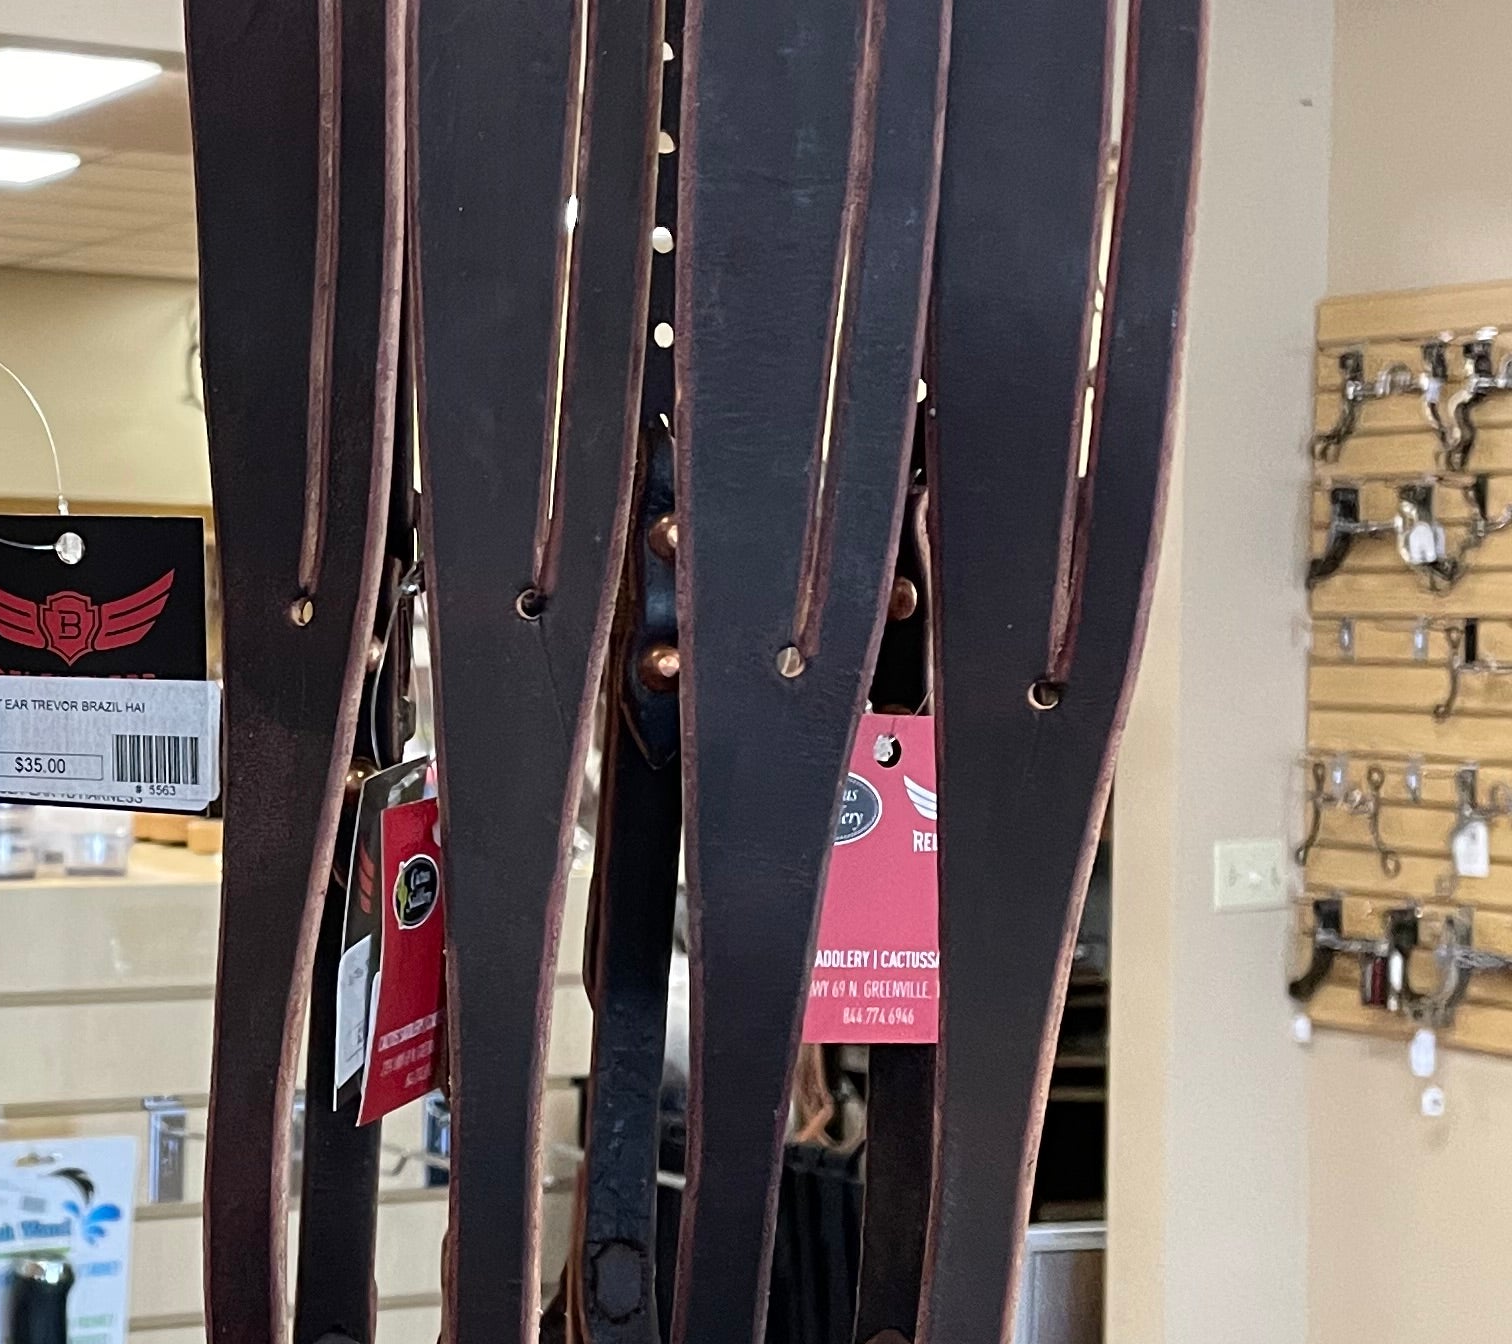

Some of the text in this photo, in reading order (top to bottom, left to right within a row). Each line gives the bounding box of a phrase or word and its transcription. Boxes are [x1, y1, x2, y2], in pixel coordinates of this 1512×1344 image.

[5, 699, 29, 711] EAR
[31, 699, 78, 712] TREVOR
[82, 700, 123, 713] BRAZIL
[14, 756, 66, 775] $35.00
[148, 784, 177, 797] 5563
